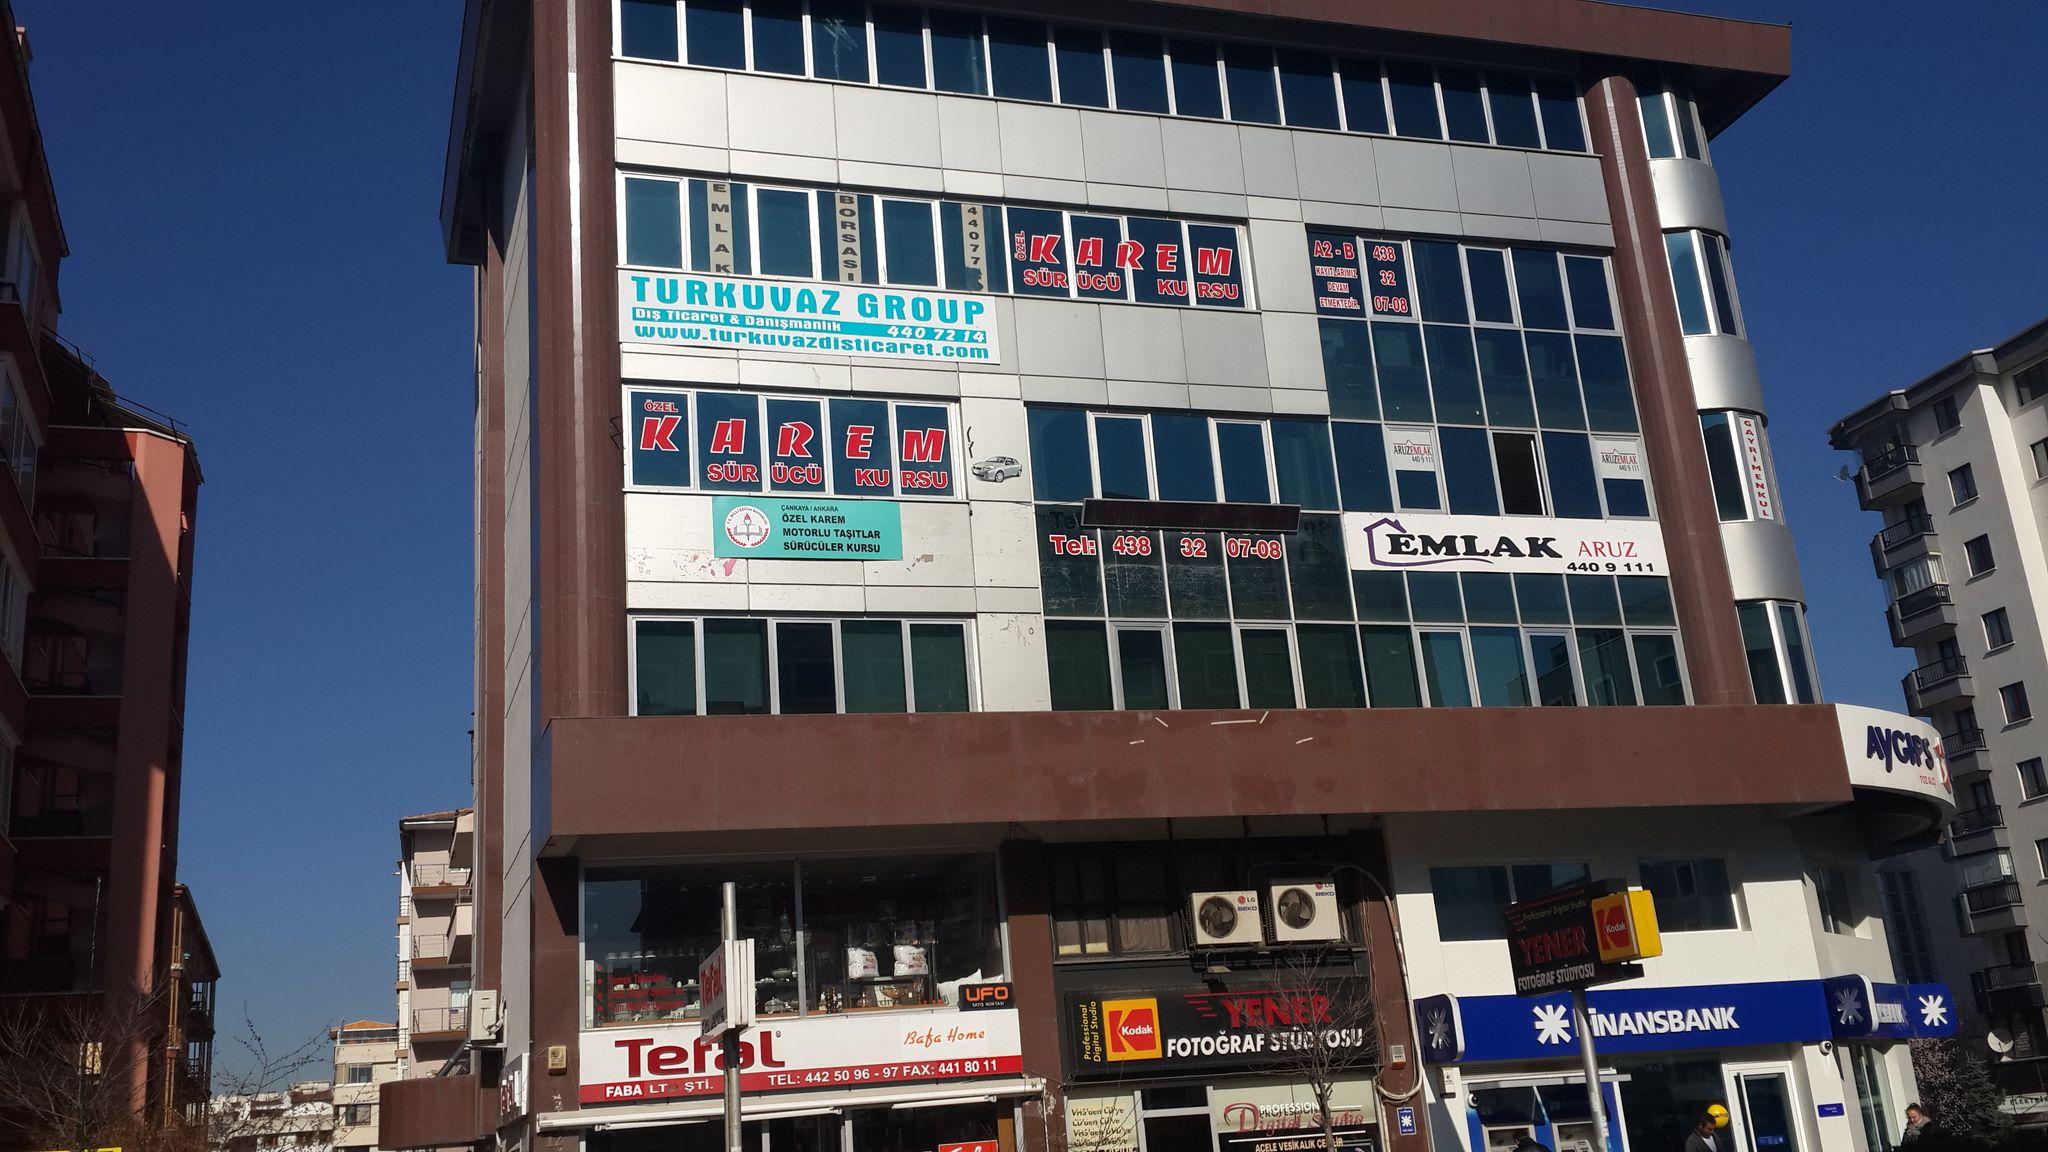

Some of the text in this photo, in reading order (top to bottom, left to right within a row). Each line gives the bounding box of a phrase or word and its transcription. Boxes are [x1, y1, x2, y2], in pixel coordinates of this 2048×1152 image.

[711, 183, 731, 273] EMLAK
[839, 195, 858, 282] BORSASI
[1015, 231, 1026, 261] ÖZEL
[1030, 235, 1232, 276] KAREM
[1314, 240, 1333, 258] A2
[1343, 242, 1355, 259] B
[1373, 245, 1396, 261] 438
[1024, 268, 1238, 300] SÜRÜCÜ KURSU
[1327, 281, 1349, 293] DEVAM
[1380, 270, 1396, 286] 32
[631, 276, 985, 325] TURKUVAZ GROUP
[1374, 295, 1408, 313] 07-08
[634, 325, 989, 360] www.turkuvazdisticaret.com
[887, 326, 926, 338] 440
[934, 328, 955, 341] 72
[963, 330, 985, 343] 14
[644, 399, 678, 413] ÖZEL
[640, 415, 946, 463] KAREM
[707, 461, 948, 489] SÜRÜCÜ KURSU
[781, 504, 809, 513] ÇANKAYA
[782, 513, 845, 524] ÖZEL KAREM
[783, 527, 880, 540] MOTORLU TAŞITLAR
[783, 540, 880, 553] SÜRÜCÜLER KURSU
[1050, 535, 1282, 560] Tel: 438 32 07-08
[1386, 533, 1564, 559] EMLAK
[1578, 540, 1638, 558] ARUZ
[1567, 562, 1654, 572] 440 9 111
[1606, 922, 1627, 934] Kodak
[1519, 926, 1590, 967] YENER
[1518, 963, 1596, 992] FOTOĞRAF STÜDYOSU
[965, 986, 1008, 1001] UFO
[1222, 994, 1333, 1028] YENER
[1573, 1006, 1741, 1037] İNANSBANK
[904, 1026, 985, 1048] Bafa Home
[1080, 1004, 1091, 1060] Professional
[1089, 1001, 1102, 1062] Digital Studio
[1121, 1024, 1154, 1036] Kodak
[615, 1030, 786, 1079] Tefal
[1167, 1030, 1265, 1057] FOTOĞRAF
[768, 1074, 801, 1086] TEL:
[805, 1071, 830, 1083] 442
[834, 1070, 850, 1082] 50
[853, 1069, 870, 1080] 96
[883, 1067, 899, 1078] 97
[903, 1064, 935, 1077] FAX:
[938, 1061, 960, 1074] 441
[964, 1060, 980, 1072] 80
[984, 1059, 997, 1071] 11
[606, 1084, 643, 1098] FABA
[1260, 1102, 1321, 1115] PROFESSION
[1309, 1110, 1364, 1128] Sudio
[1280, 1138, 1315, 1151] VESİKALIK
